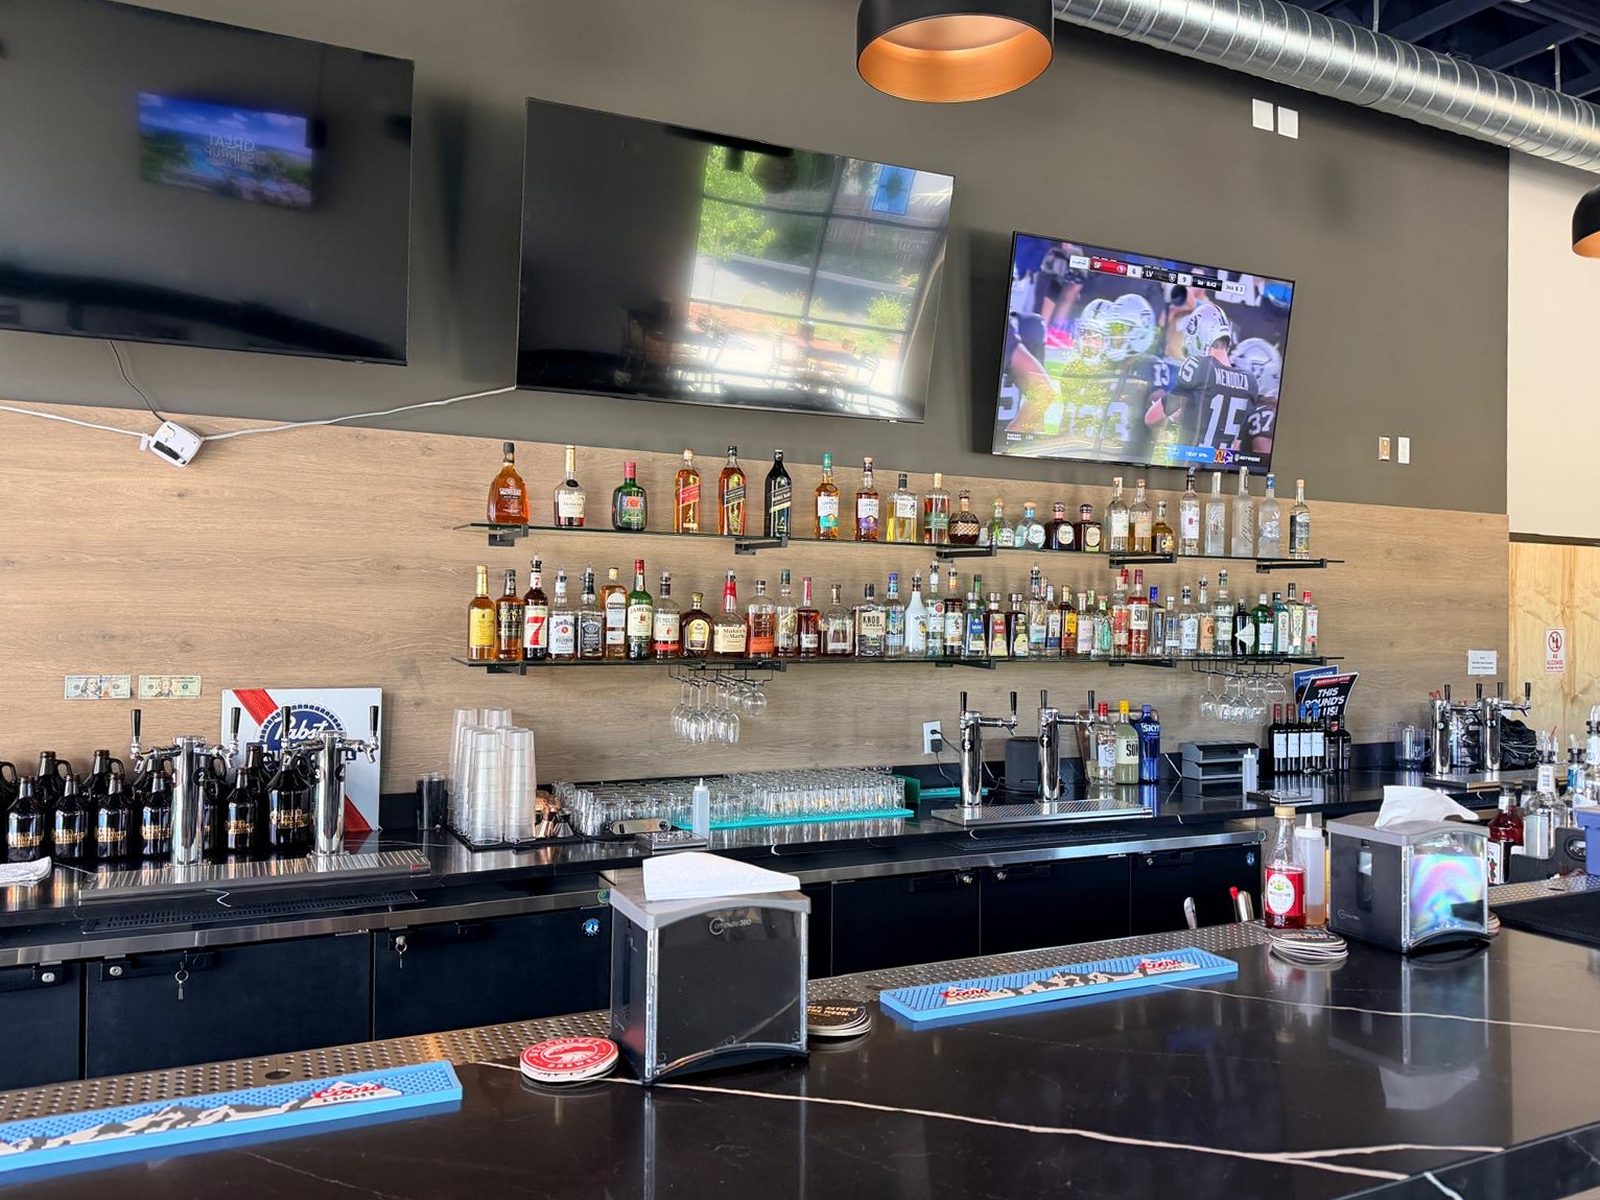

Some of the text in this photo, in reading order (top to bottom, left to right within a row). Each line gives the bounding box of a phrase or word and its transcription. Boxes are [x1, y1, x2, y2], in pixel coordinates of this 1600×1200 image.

[1093, 261, 1102, 269] SF
[1214, 367, 1249, 391] MENDOZA
[1199, 393, 1249, 449] 15
[1247, 410, 1274, 436] 37
[534, 577, 541, 586] 7
[863, 615, 880, 624] KNOB
[526, 616, 547, 646] 7
[1317, 687, 1340, 698] THIS
[274, 715, 329, 740] Pabst
[1042, 737, 1049, 746] 7
[199, 771, 205, 782] 2
[314, 769, 320, 779] 3
